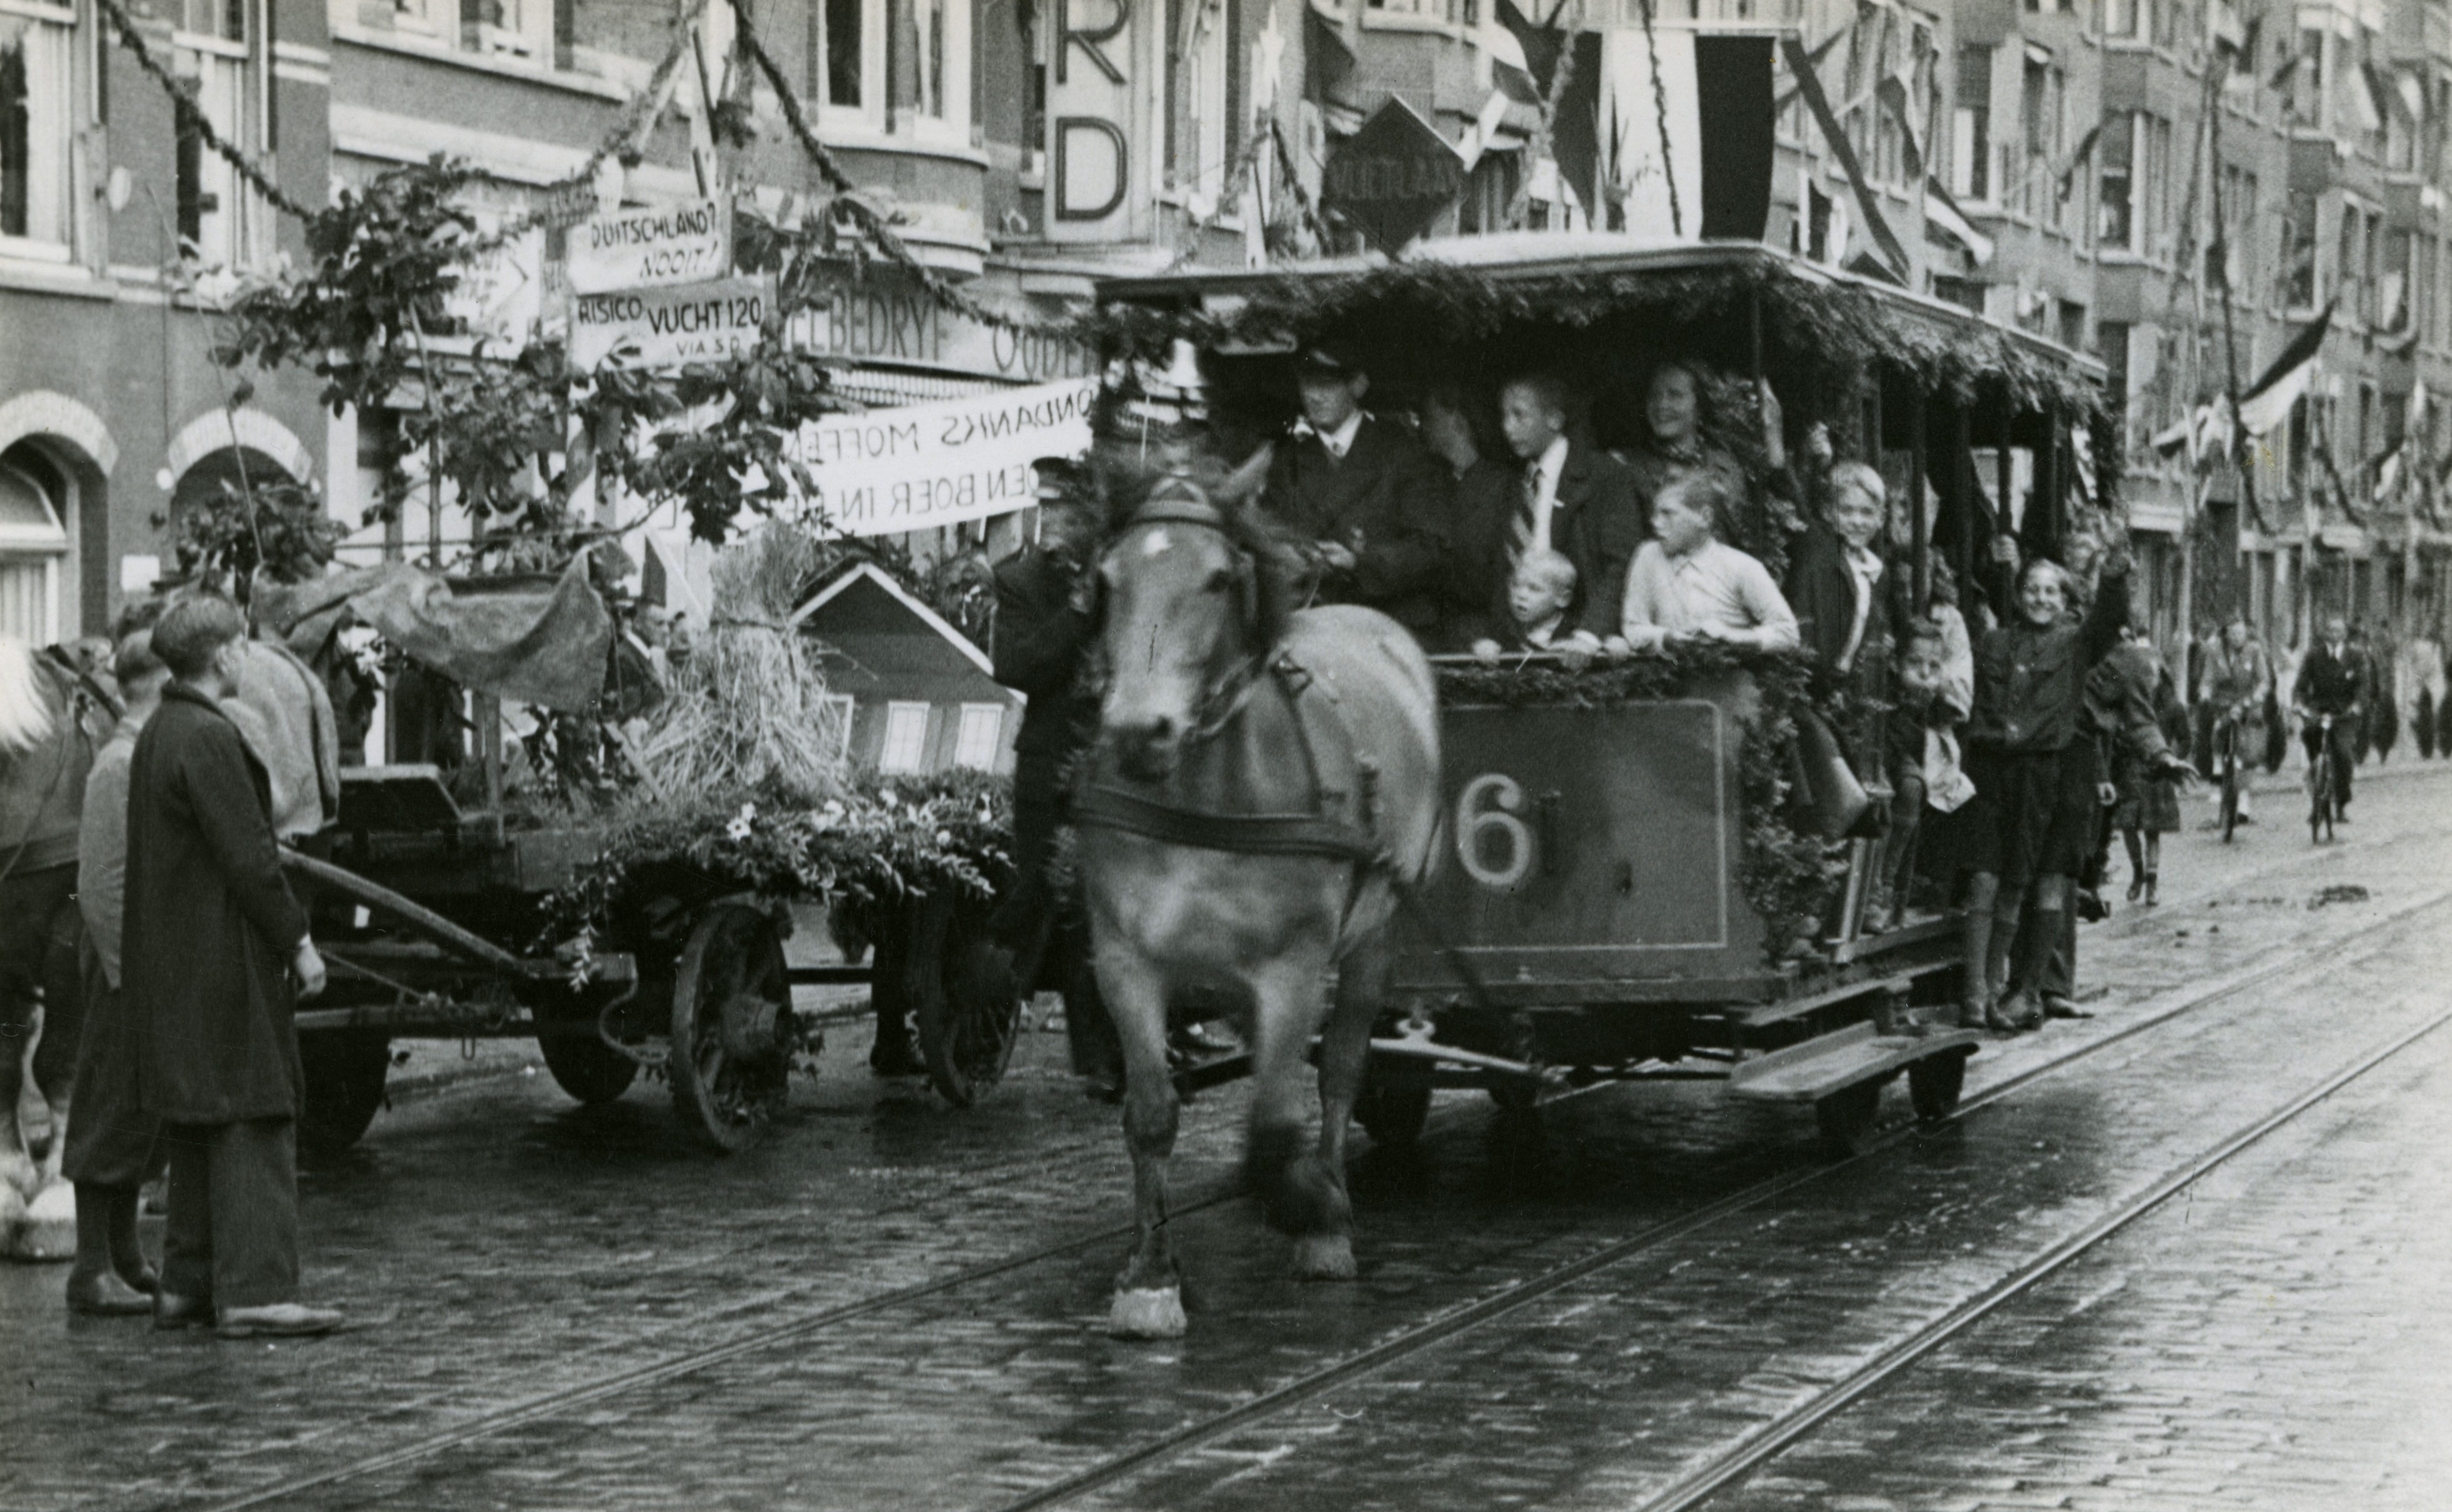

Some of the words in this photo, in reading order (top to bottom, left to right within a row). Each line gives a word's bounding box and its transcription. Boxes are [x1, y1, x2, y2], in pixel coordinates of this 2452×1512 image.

[592, 201, 716, 248] DUITSCHLAND?
[578, 296, 642, 325] RISICO
[1457, 773, 1530, 887] 6
